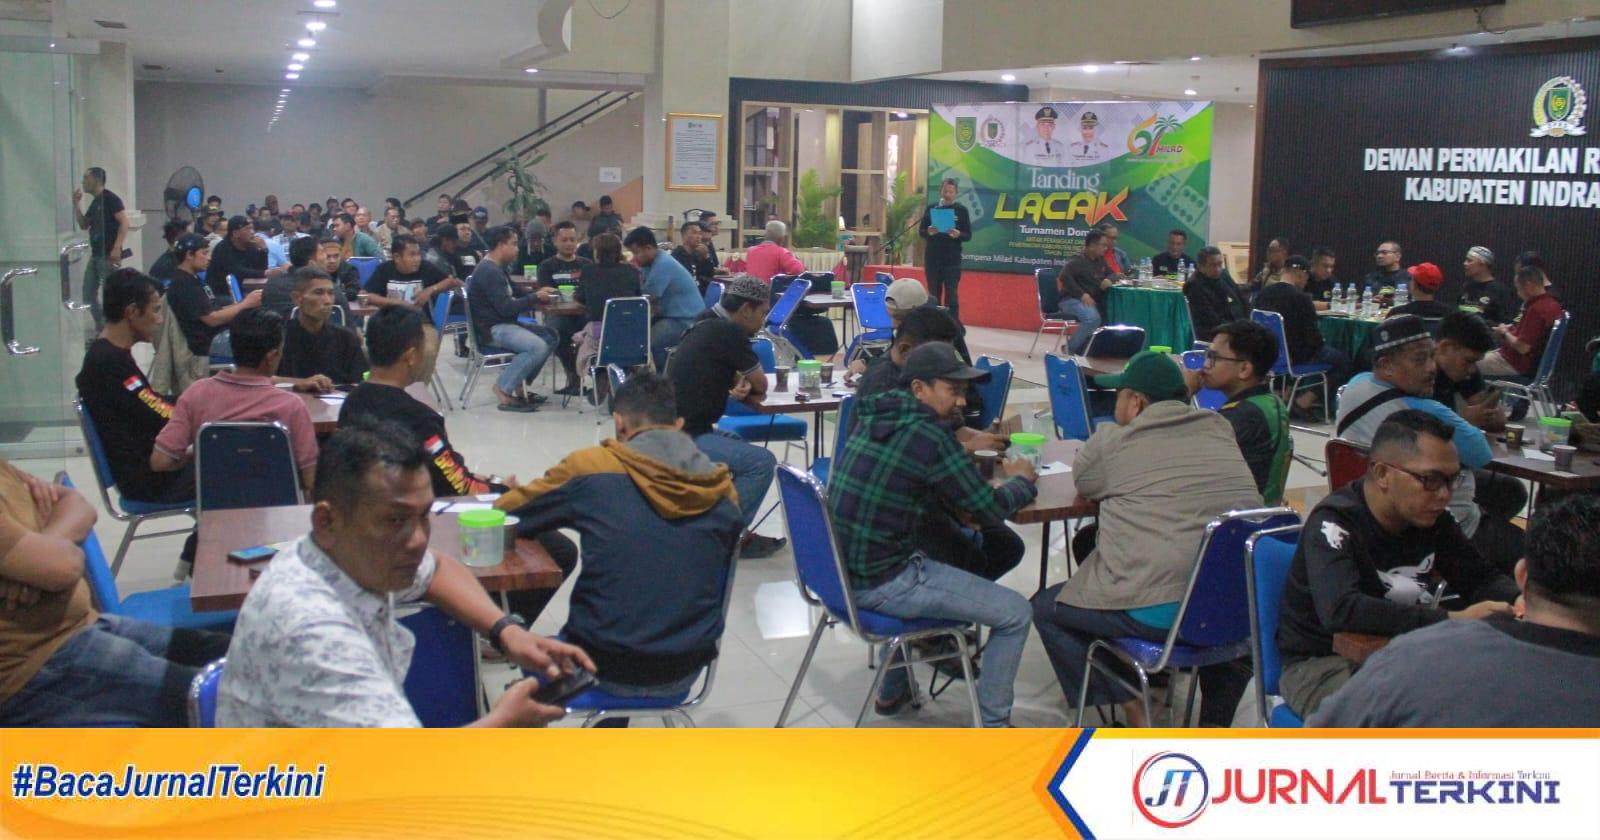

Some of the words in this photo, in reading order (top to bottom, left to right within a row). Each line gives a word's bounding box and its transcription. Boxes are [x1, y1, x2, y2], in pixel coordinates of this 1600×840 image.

[1364, 148, 1432, 171] DEWAN
[1437, 148, 1578, 174] PERWAKILAN
[1028, 167, 1100, 194] Tanding
[1405, 177, 1525, 206] KABUPATEN
[1530, 180, 1600, 208] INDRA
[994, 187, 1128, 225] LACAK
[1020, 225, 1064, 235] Turnamen
[1067, 227, 1093, 237] Dom
[993, 254, 1013, 262] Milad
